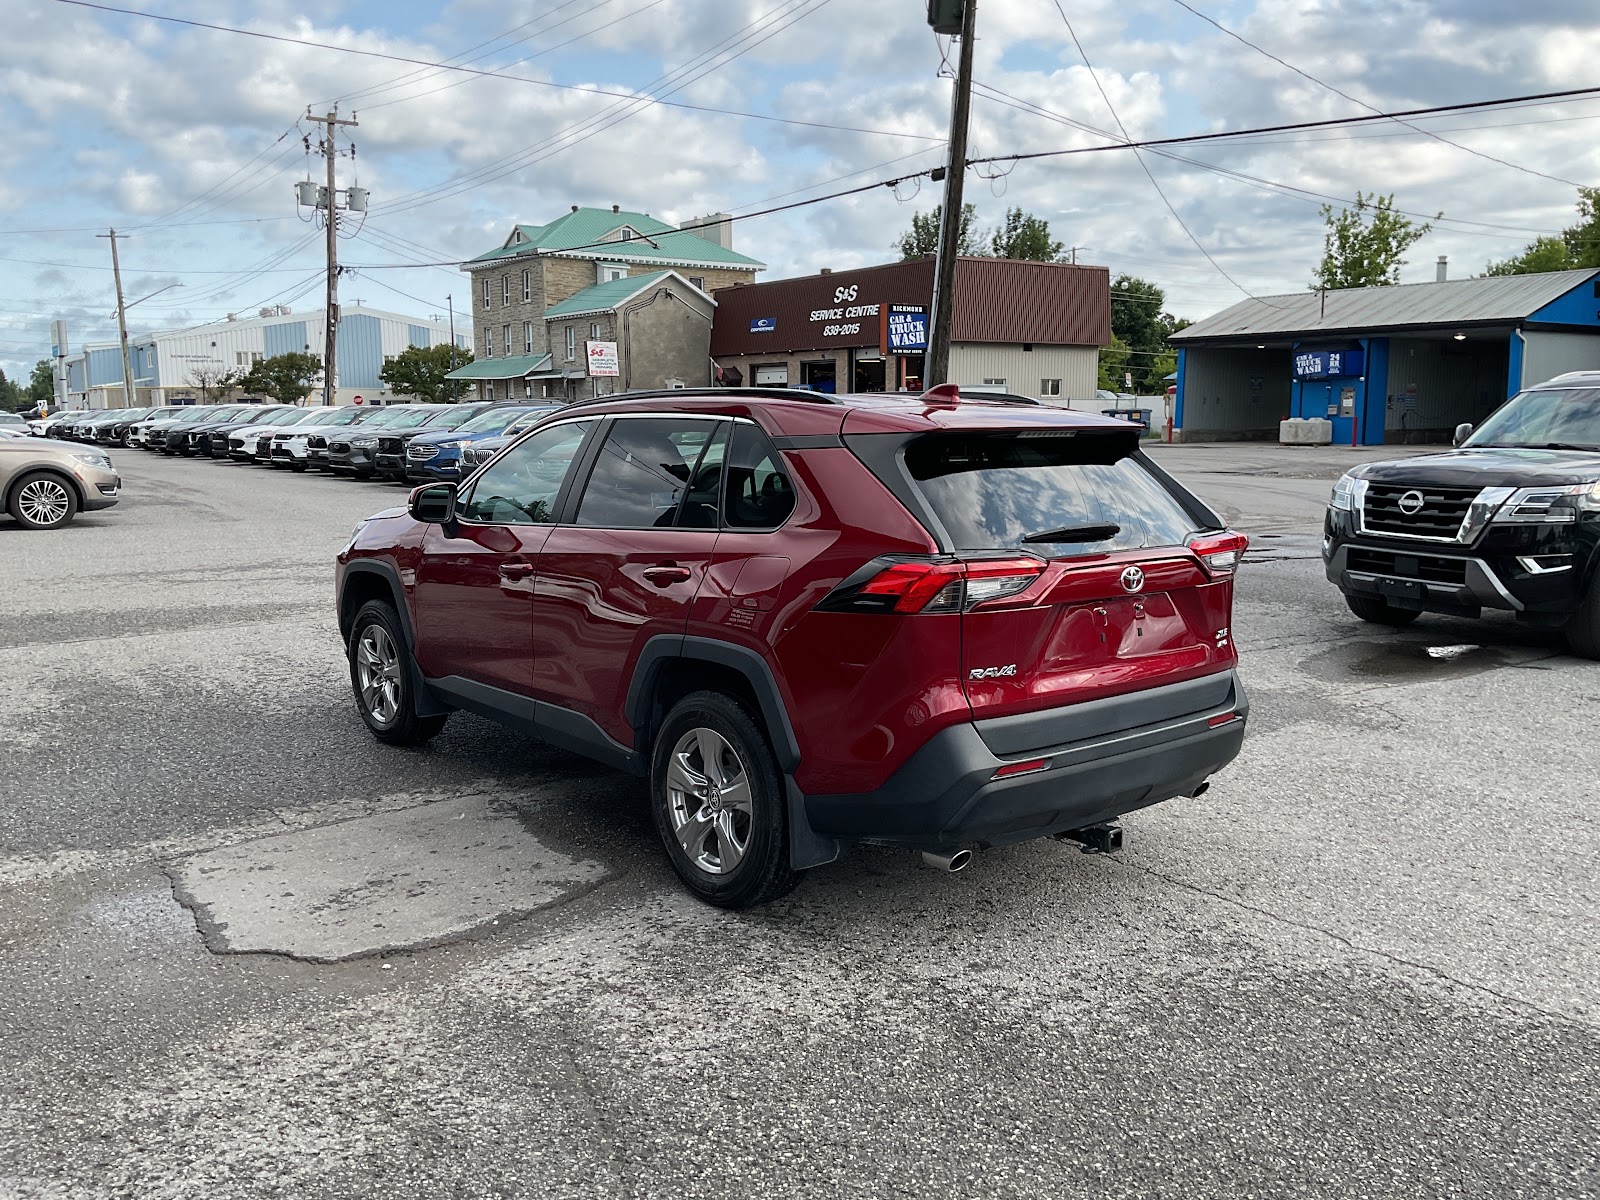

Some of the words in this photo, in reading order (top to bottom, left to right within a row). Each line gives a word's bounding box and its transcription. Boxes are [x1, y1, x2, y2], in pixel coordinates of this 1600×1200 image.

[834, 285, 858, 303] S&S
[809, 308, 844, 321] SERVICE
[845, 304, 880, 318] CENTRE
[890, 315, 904, 324] CAR
[906, 314, 912, 323] &
[823, 323, 860, 336] 838-2015
[890, 321, 925, 334] TRUCK
[891, 332, 926, 346] WASH
[1296, 357, 1321, 367] TRUCK
[1297, 364, 1321, 375] WASH
[969, 664, 1016, 679] RAV4
